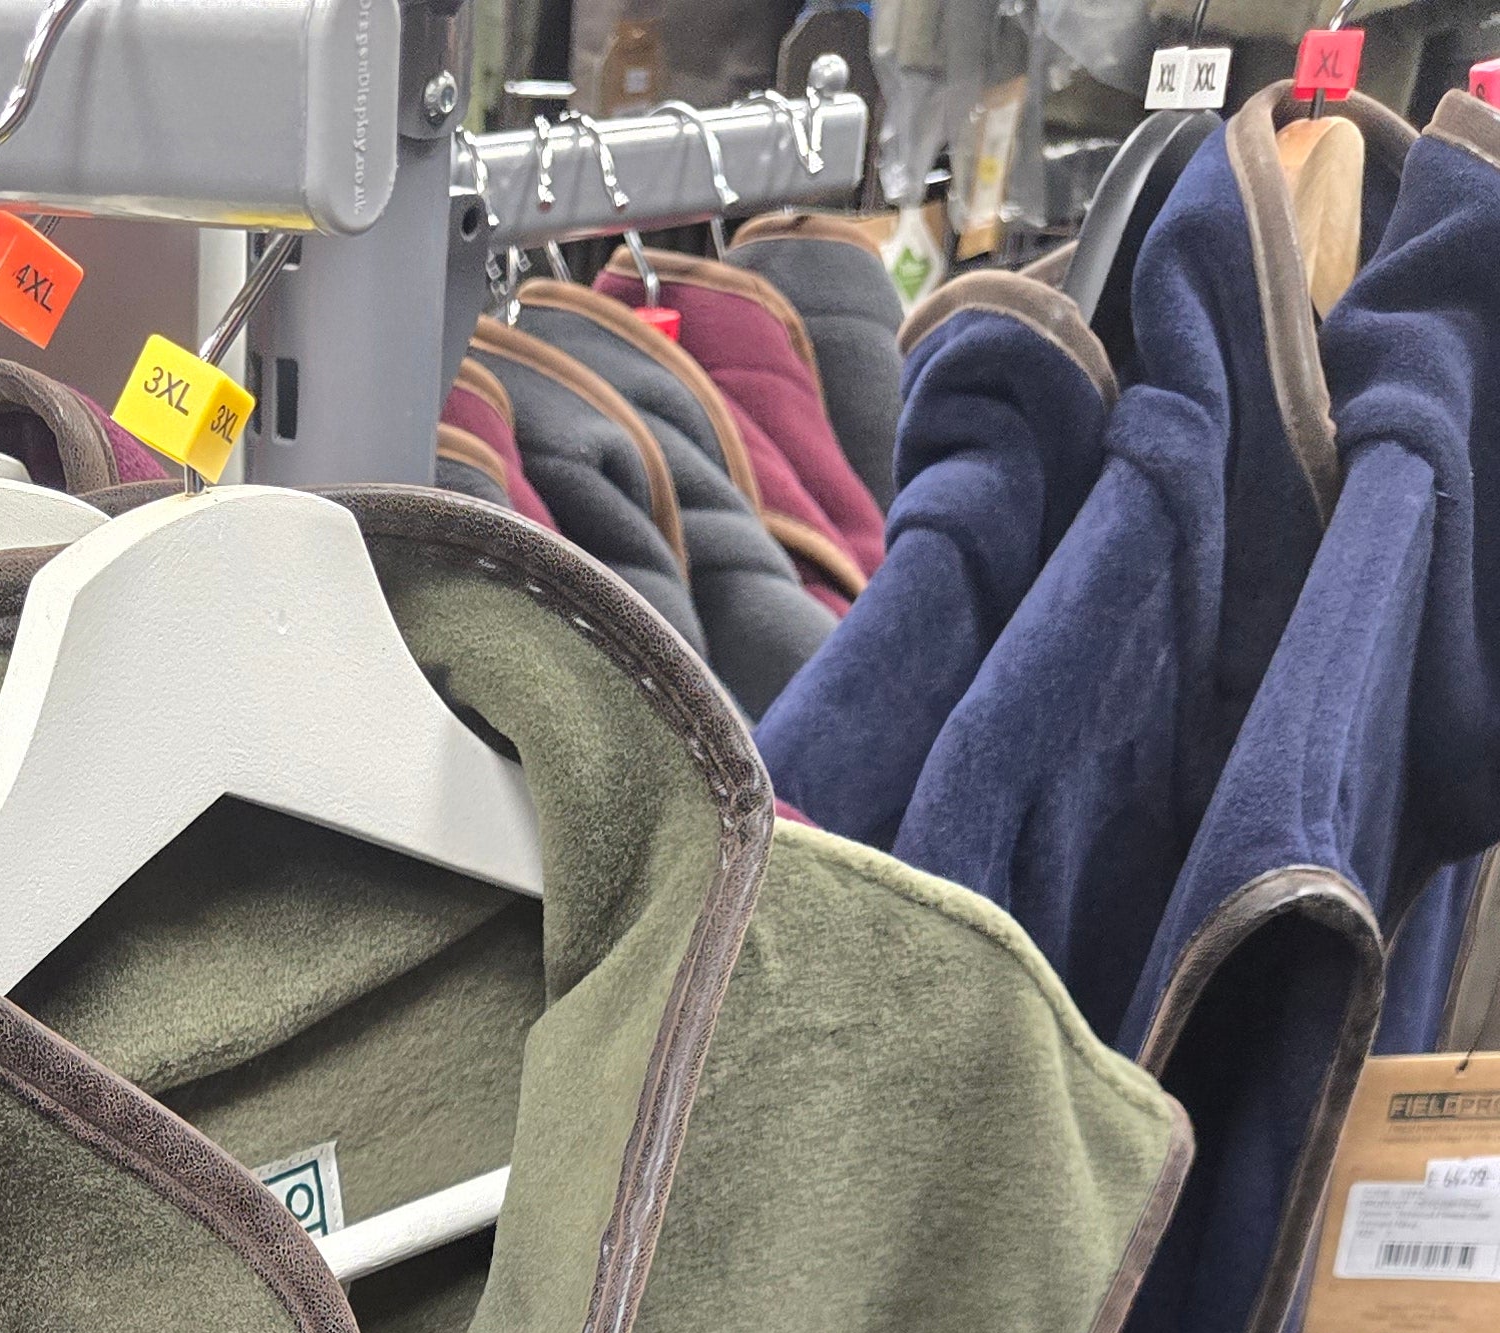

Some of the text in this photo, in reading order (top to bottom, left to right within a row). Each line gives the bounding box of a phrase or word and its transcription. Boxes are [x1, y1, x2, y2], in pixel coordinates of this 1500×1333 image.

[1156, 63, 1176, 92] XXL
[1193, 62, 1216, 92] XXL
[1314, 48, 1343, 78] XL
[14, 264, 55, 313] 4XL
[143, 365, 192, 416] 3XL
[210, 404, 238, 444] 3XL
